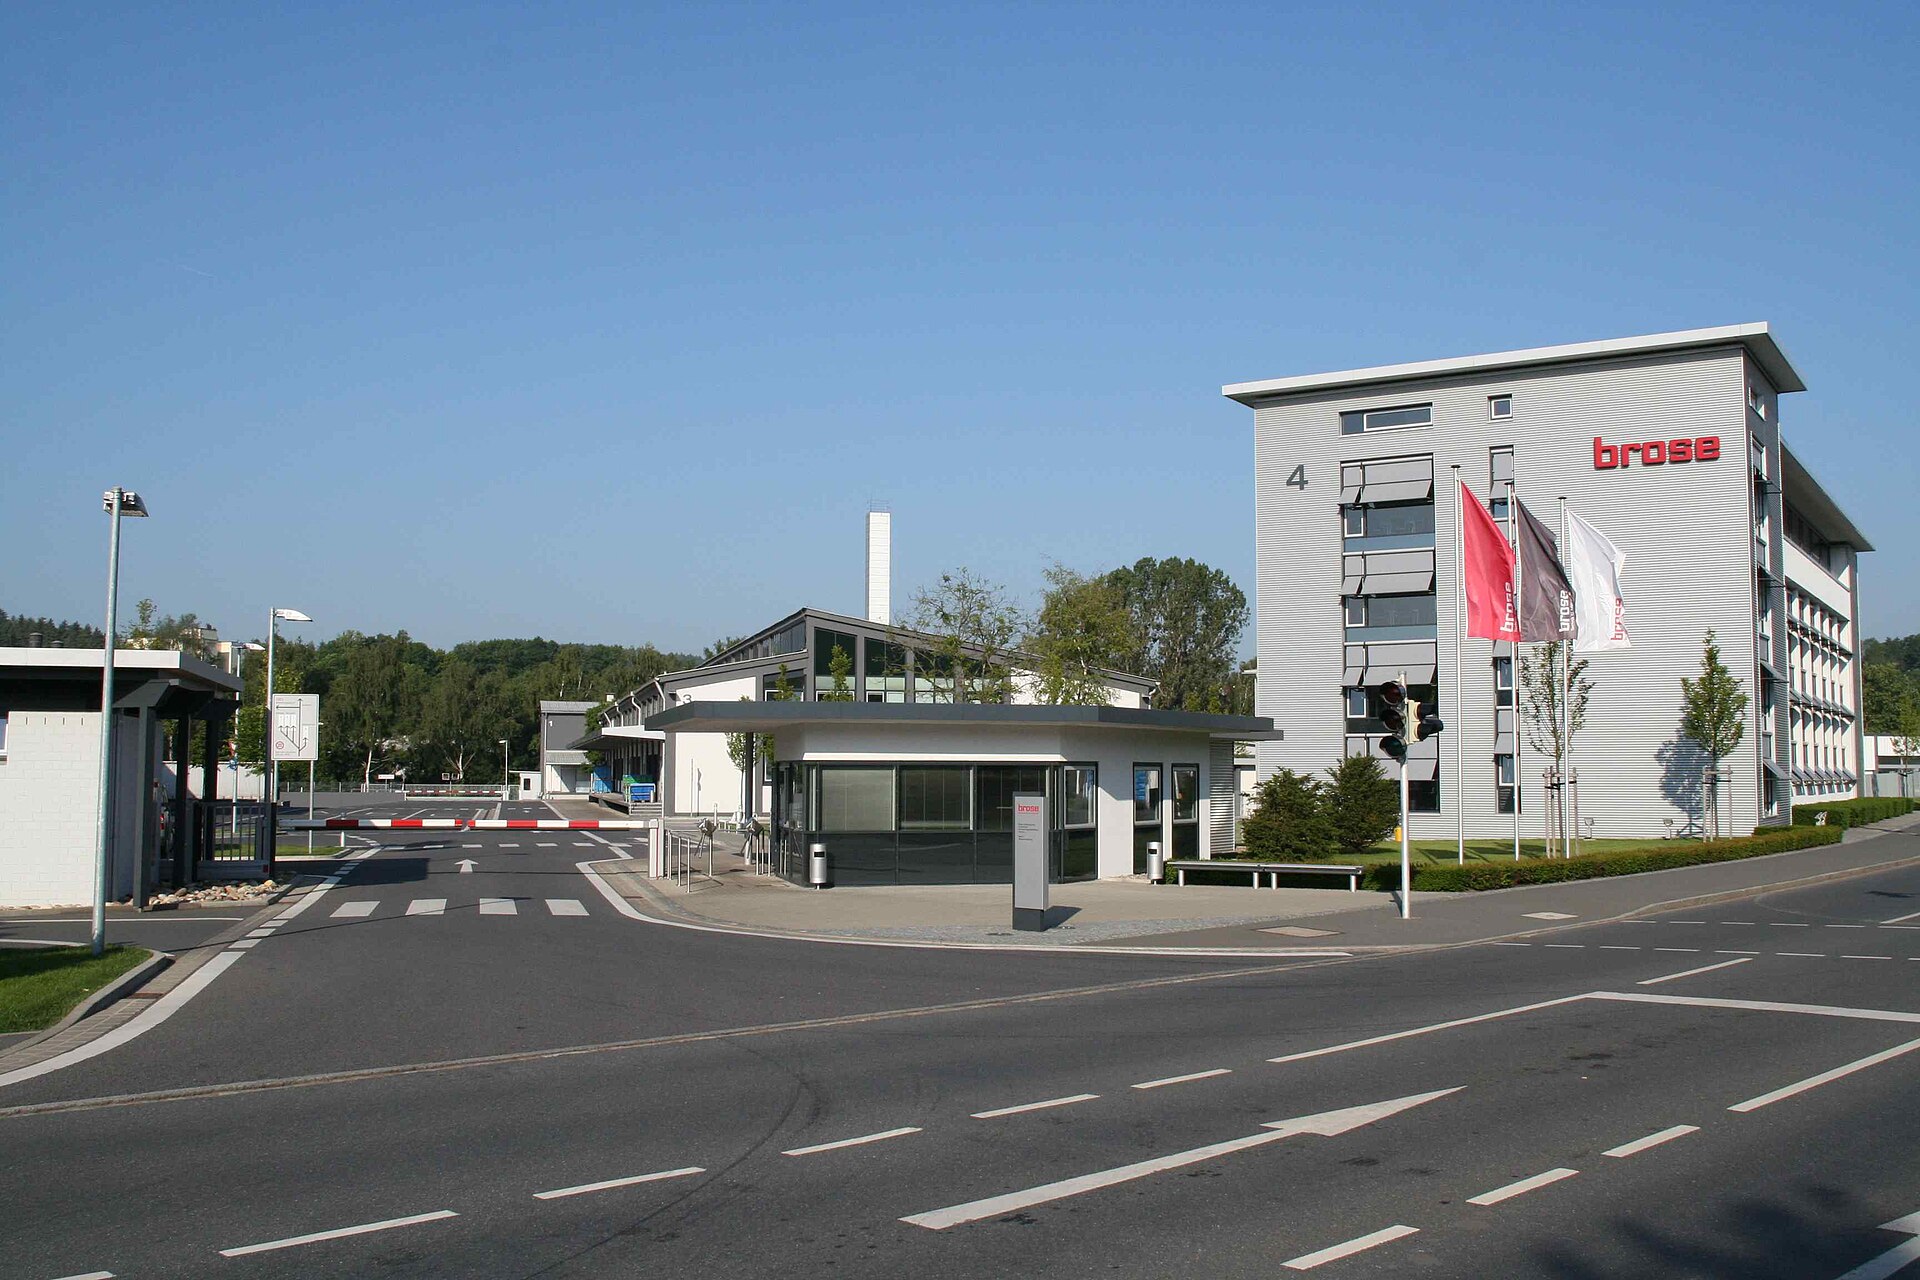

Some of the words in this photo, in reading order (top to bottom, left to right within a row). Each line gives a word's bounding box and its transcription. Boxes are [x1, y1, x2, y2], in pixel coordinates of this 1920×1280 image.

[1593, 435, 1721, 469] brose
[1286, 464, 1309, 490] 4
[1559, 590, 1571, 632] brose
[1018, 804, 1040, 812] brose
